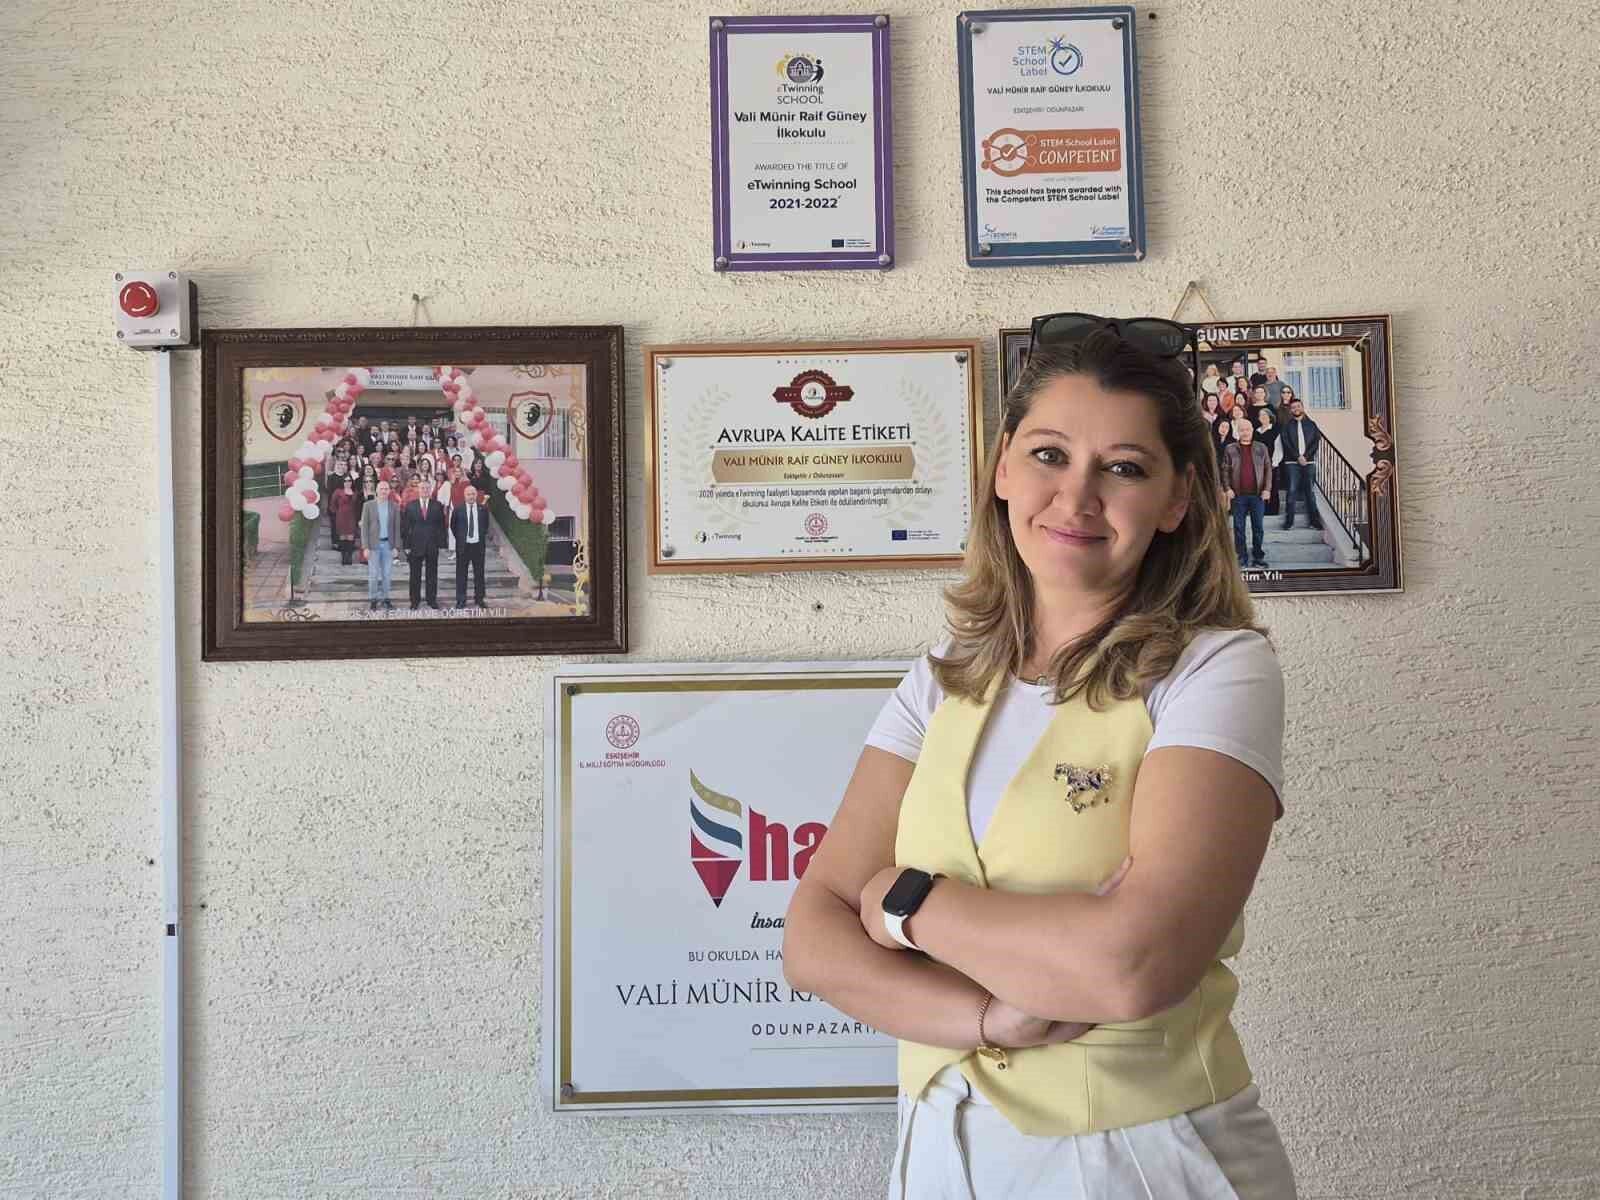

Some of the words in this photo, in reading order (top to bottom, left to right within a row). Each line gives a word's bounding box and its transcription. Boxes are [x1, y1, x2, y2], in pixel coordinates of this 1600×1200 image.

[1018, 46, 1046, 56] STEM
[1012, 56, 1047, 66] School
[1020, 66, 1047, 76] Label
[777, 83, 824, 95] eTwinning
[1048, 84, 1073, 93] GÜNEY
[777, 95, 823, 105] SCHOOL
[735, 111, 756, 122] Vali
[760, 111, 796, 122] Münir
[800, 110, 822, 121] Raif
[826, 110, 867, 123] Güney
[777, 126, 826, 138] İlkokulu
[1039, 138, 1063, 147] STEM
[1064, 138, 1092, 146] School
[1093, 137, 1116, 145] Label
[1039, 149, 1117, 165] COMPETENT
[754, 162, 794, 171] AWARDED
[797, 162, 812, 171] THE
[815, 162, 835, 170] TITLE
[837, 162, 848, 170] OF
[747, 179, 810, 192] eTwinning
[814, 178, 857, 190] School
[985, 187, 1001, 196] This
[1003, 187, 1029, 195] school
[1030, 187, 1044, 195] has
[1046, 186, 1066, 194] been
[1068, 186, 1103, 194] awarded
[1105, 185, 1122, 193] with
[769, 197, 838, 210] 2021-2022
[986, 196, 999, 204] the
[1000, 195, 1045, 204] Competent
[1047, 194, 1068, 202] STEM
[1069, 194, 1096, 202] School
[1098, 193, 1120, 201] Label
[1260, 322, 1343, 340] İLKOKULU
[718, 427, 786, 443] AVRUPA
[791, 425, 846, 441] KALİTE
[852, 423, 911, 441] ETİKETİ
[749, 454, 784, 466] MÜNİR
[787, 454, 809, 465] RAİF
[812, 453, 848, 465] GÜNEY
[851, 452, 902, 464] İLKOKULU
[688, 951, 704, 962] BU
[707, 950, 759, 962] OKULDA
[616, 979, 679, 1006] VALİ
[687, 977, 780, 1005] MÜNİR
